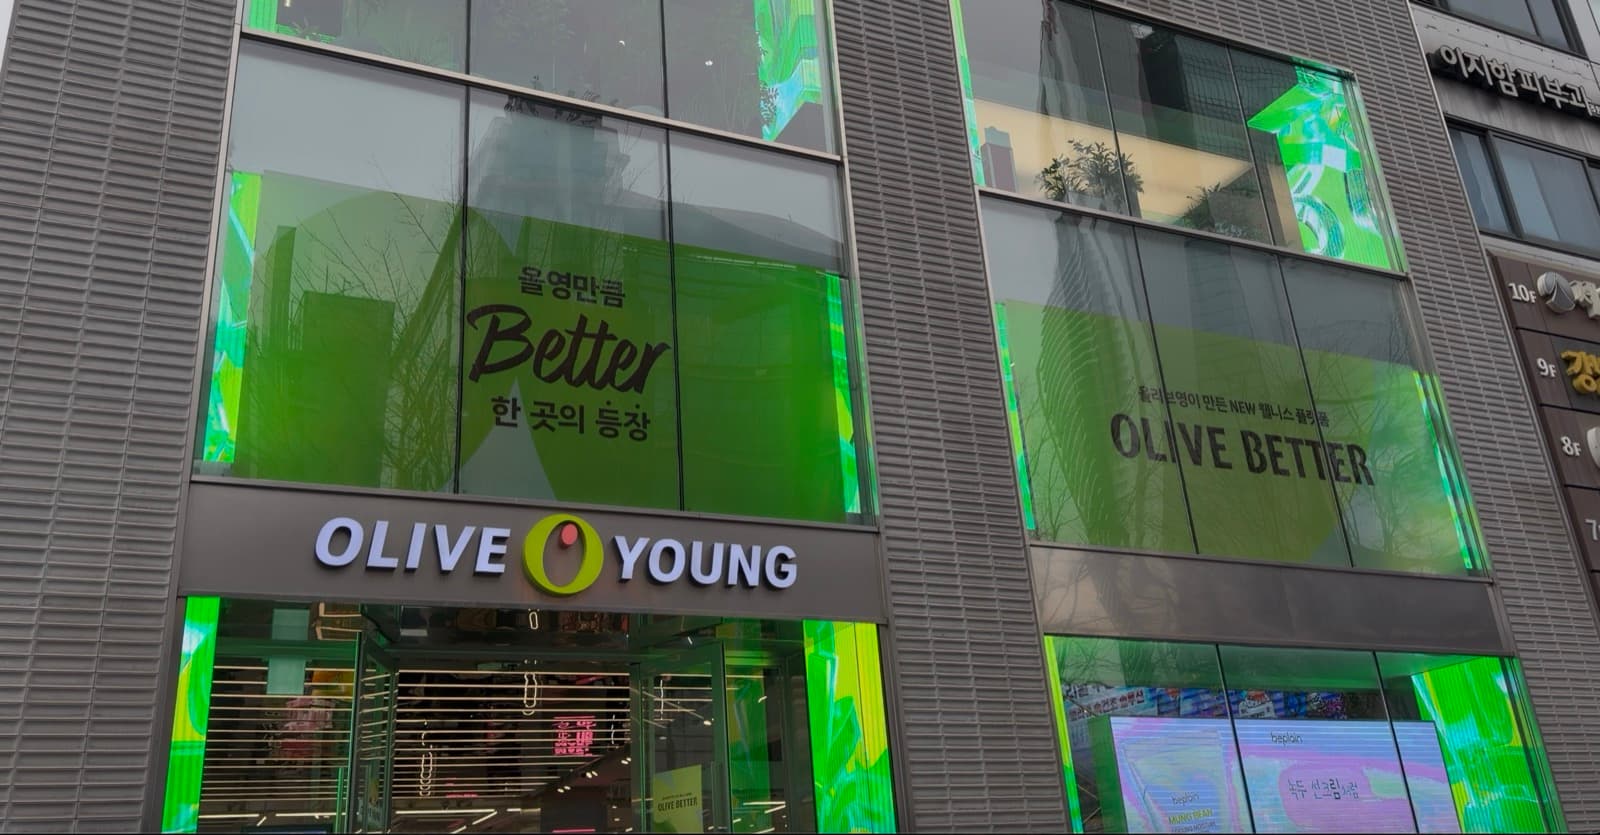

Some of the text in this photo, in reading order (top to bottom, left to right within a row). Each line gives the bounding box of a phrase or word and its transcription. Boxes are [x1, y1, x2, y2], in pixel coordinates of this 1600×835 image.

[1439, 46, 1592, 116] 이지함피부과
[518, 265, 626, 309] 올영만큼
[1508, 282, 1537, 304] 10F
[466, 303, 672, 394] Better
[1536, 357, 1557, 378] 9F
[490, 395, 651, 442] 한 곳의 등장
[1138, 385, 1330, 428] 올리브영이 만든 NEW 웰니스 플랫폼
[1110, 412, 1375, 486] OLIVE BETTER
[1560, 435, 1581, 456] 8F
[1585, 518, 1600, 541] 7
[313, 516, 511, 576] OLIVE
[613, 534, 798, 590] YOUNG
[1270, 731, 1303, 747] beplain
[675, 796, 698, 809] BETTER
[1287, 779, 1307, 800] 녹두
